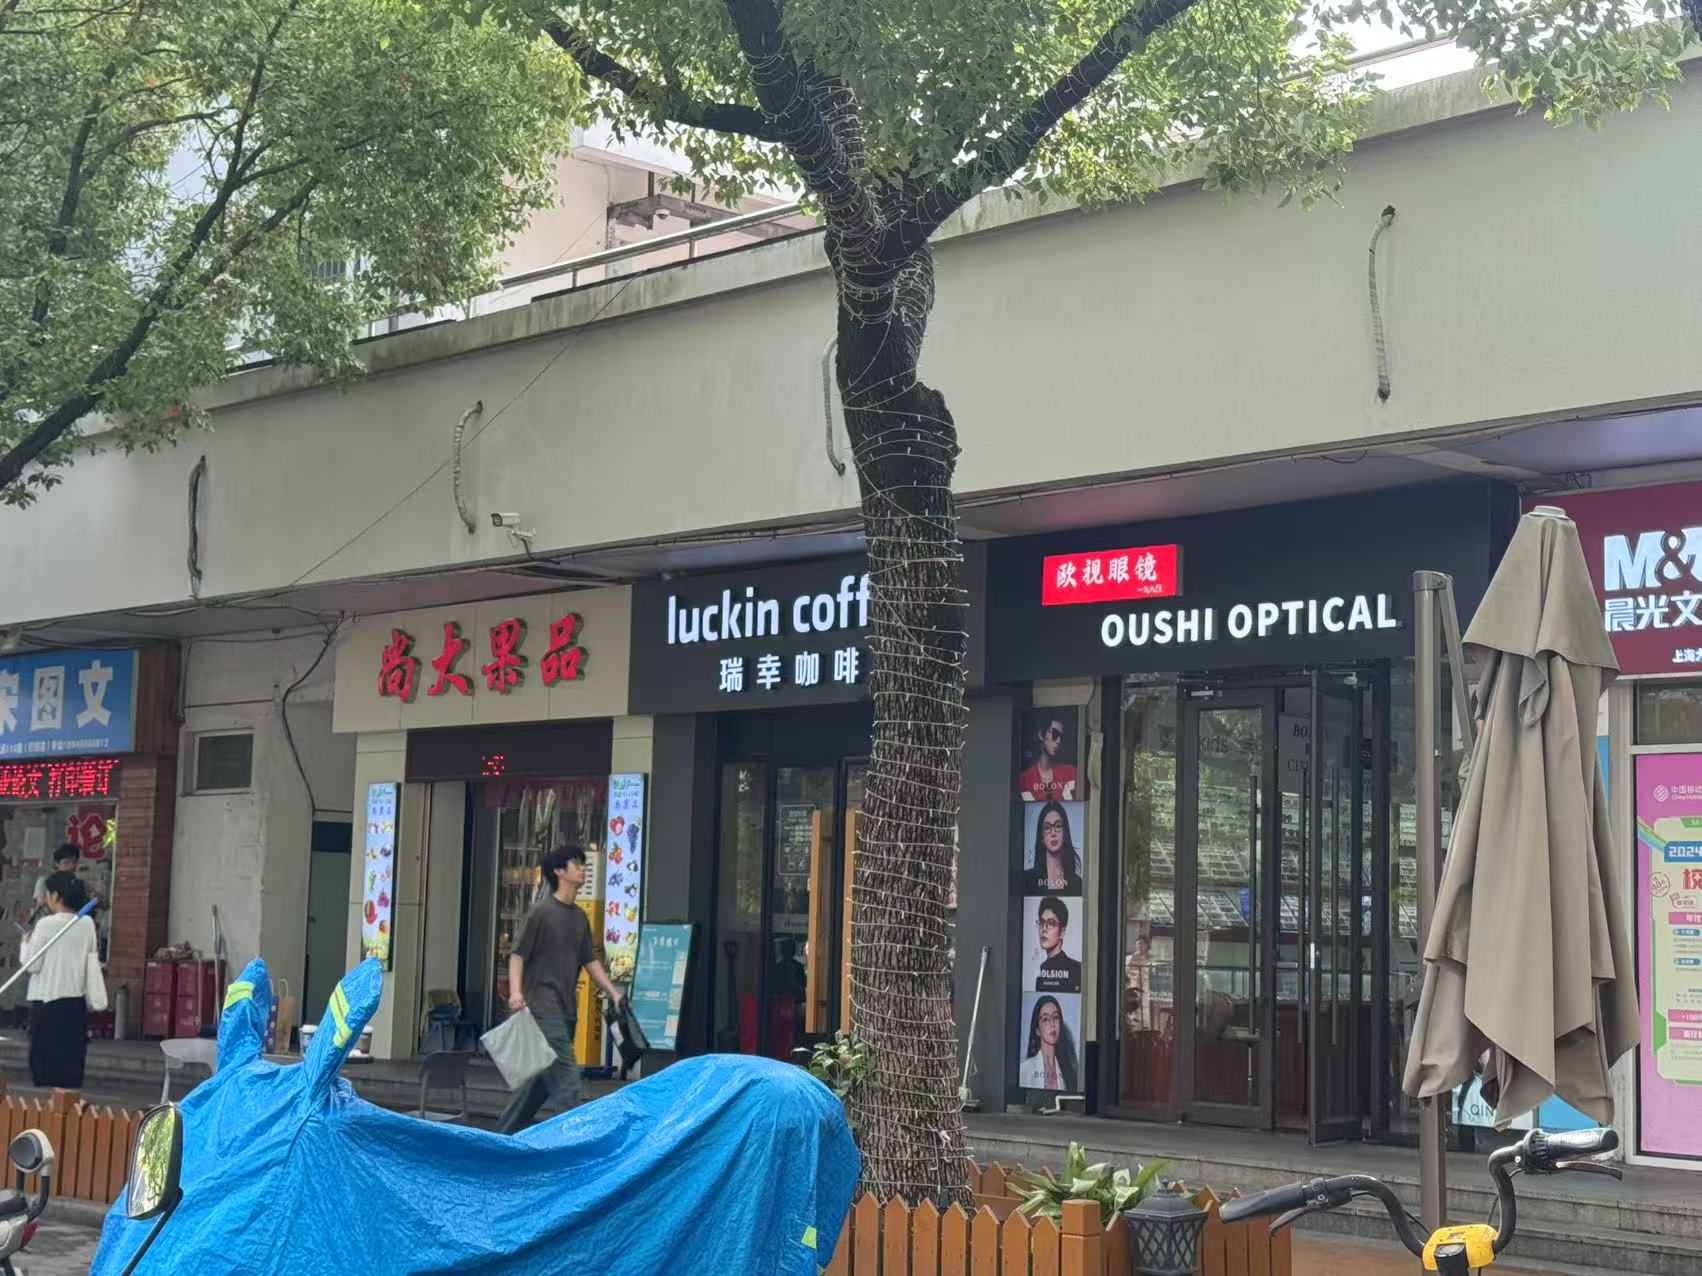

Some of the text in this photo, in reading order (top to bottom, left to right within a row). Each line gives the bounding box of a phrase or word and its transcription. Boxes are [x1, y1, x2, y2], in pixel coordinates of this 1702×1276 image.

[1056, 552, 1158, 589] 欧视眼镜
[667, 573, 870, 645] luckin coff
[1101, 592, 1397, 648] OUSHI OPTICAL
[1604, 591, 1702, 632] 晨光文
[378, 612, 588, 704] 尚大果品
[719, 646, 859, 693] 瑞幸咖啡
[1668, 846, 1702, 857] 2024
